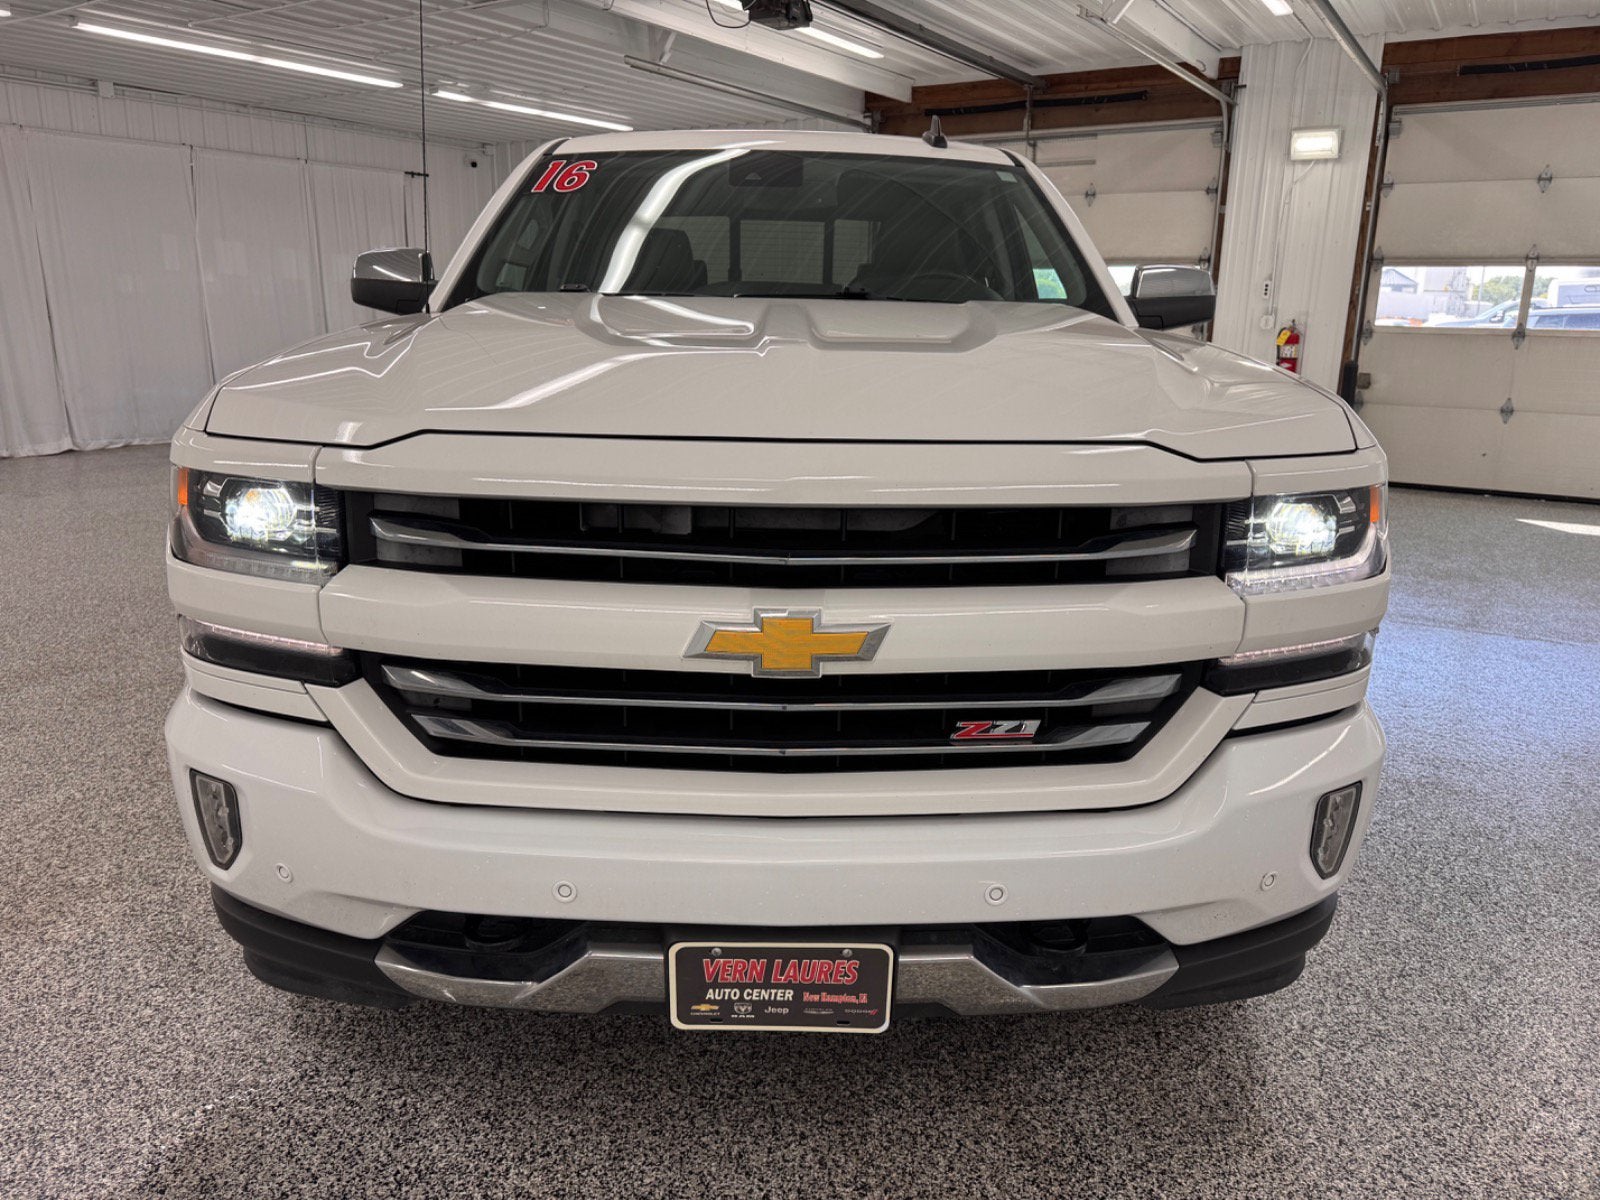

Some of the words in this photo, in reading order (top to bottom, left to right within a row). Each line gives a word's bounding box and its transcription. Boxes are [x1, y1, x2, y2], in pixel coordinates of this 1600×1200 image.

[531, 160, 598, 193] 16
[950, 719, 1041, 739] Z71
[703, 959, 767, 983] VERN
[771, 959, 860, 985] LAURES
[705, 988, 740, 1001] AUTO
[743, 988, 794, 1001] CENTER
[803, 992, 819, 1002] New
[764, 1006, 790, 1015] Jeep
